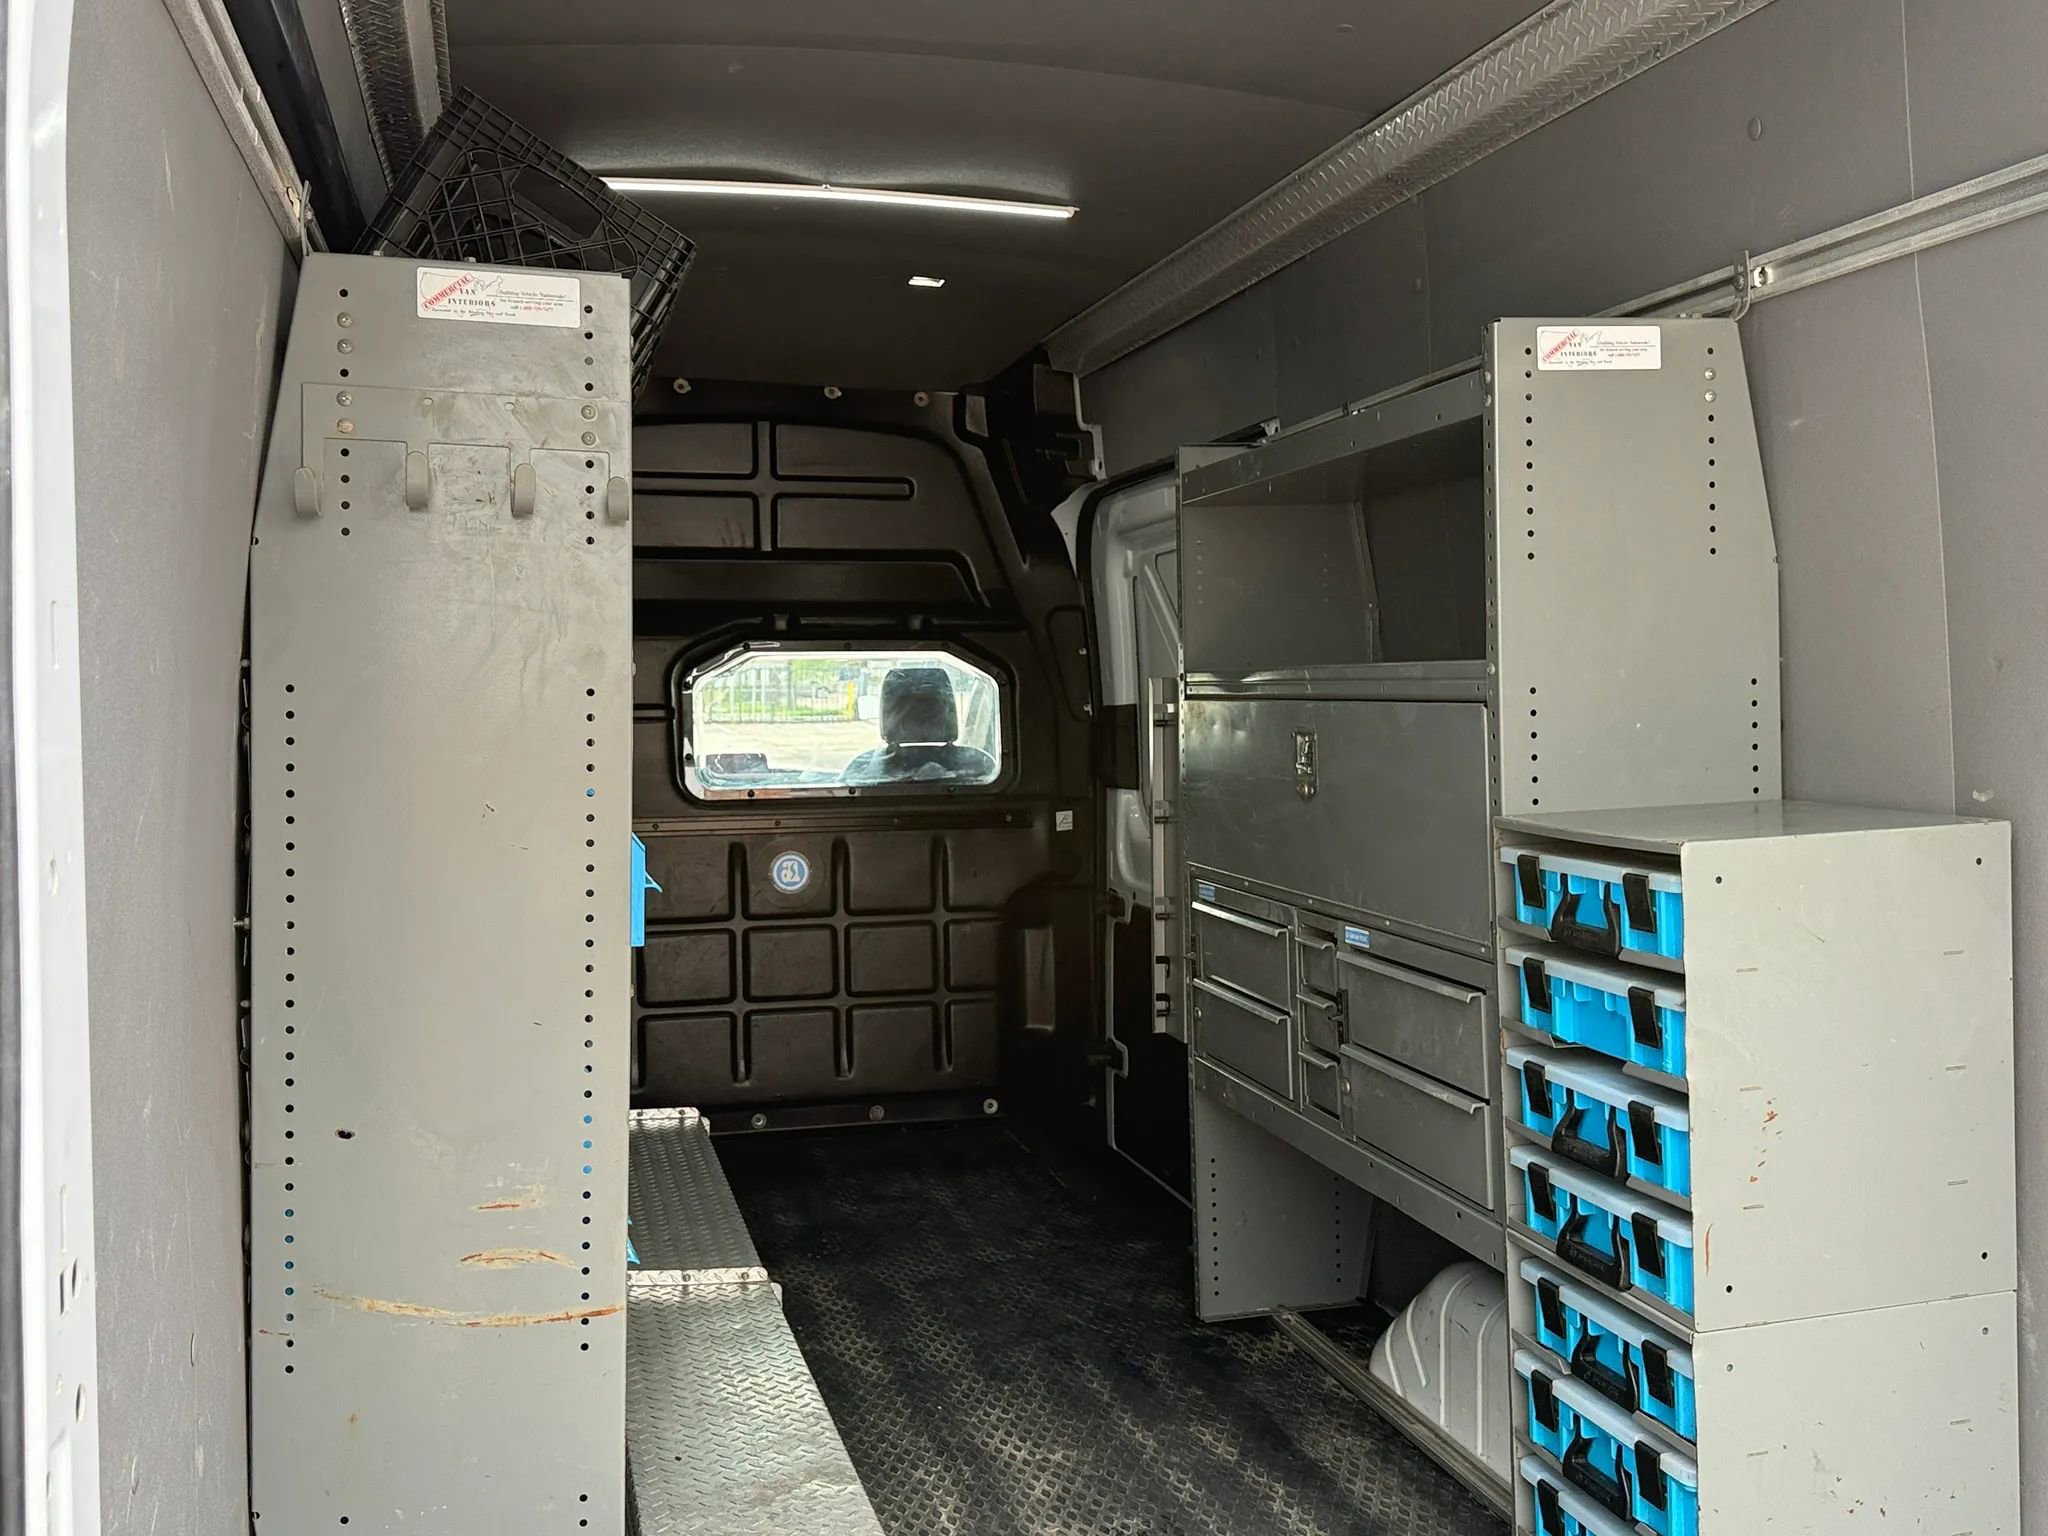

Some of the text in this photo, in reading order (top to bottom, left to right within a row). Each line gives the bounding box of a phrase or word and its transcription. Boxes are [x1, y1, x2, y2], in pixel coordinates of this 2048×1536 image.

[423, 275, 471, 309] COMMERCIAL
[448, 298, 496, 307] INTERIORS
[1543, 330, 1578, 362] COMMERCIAL
